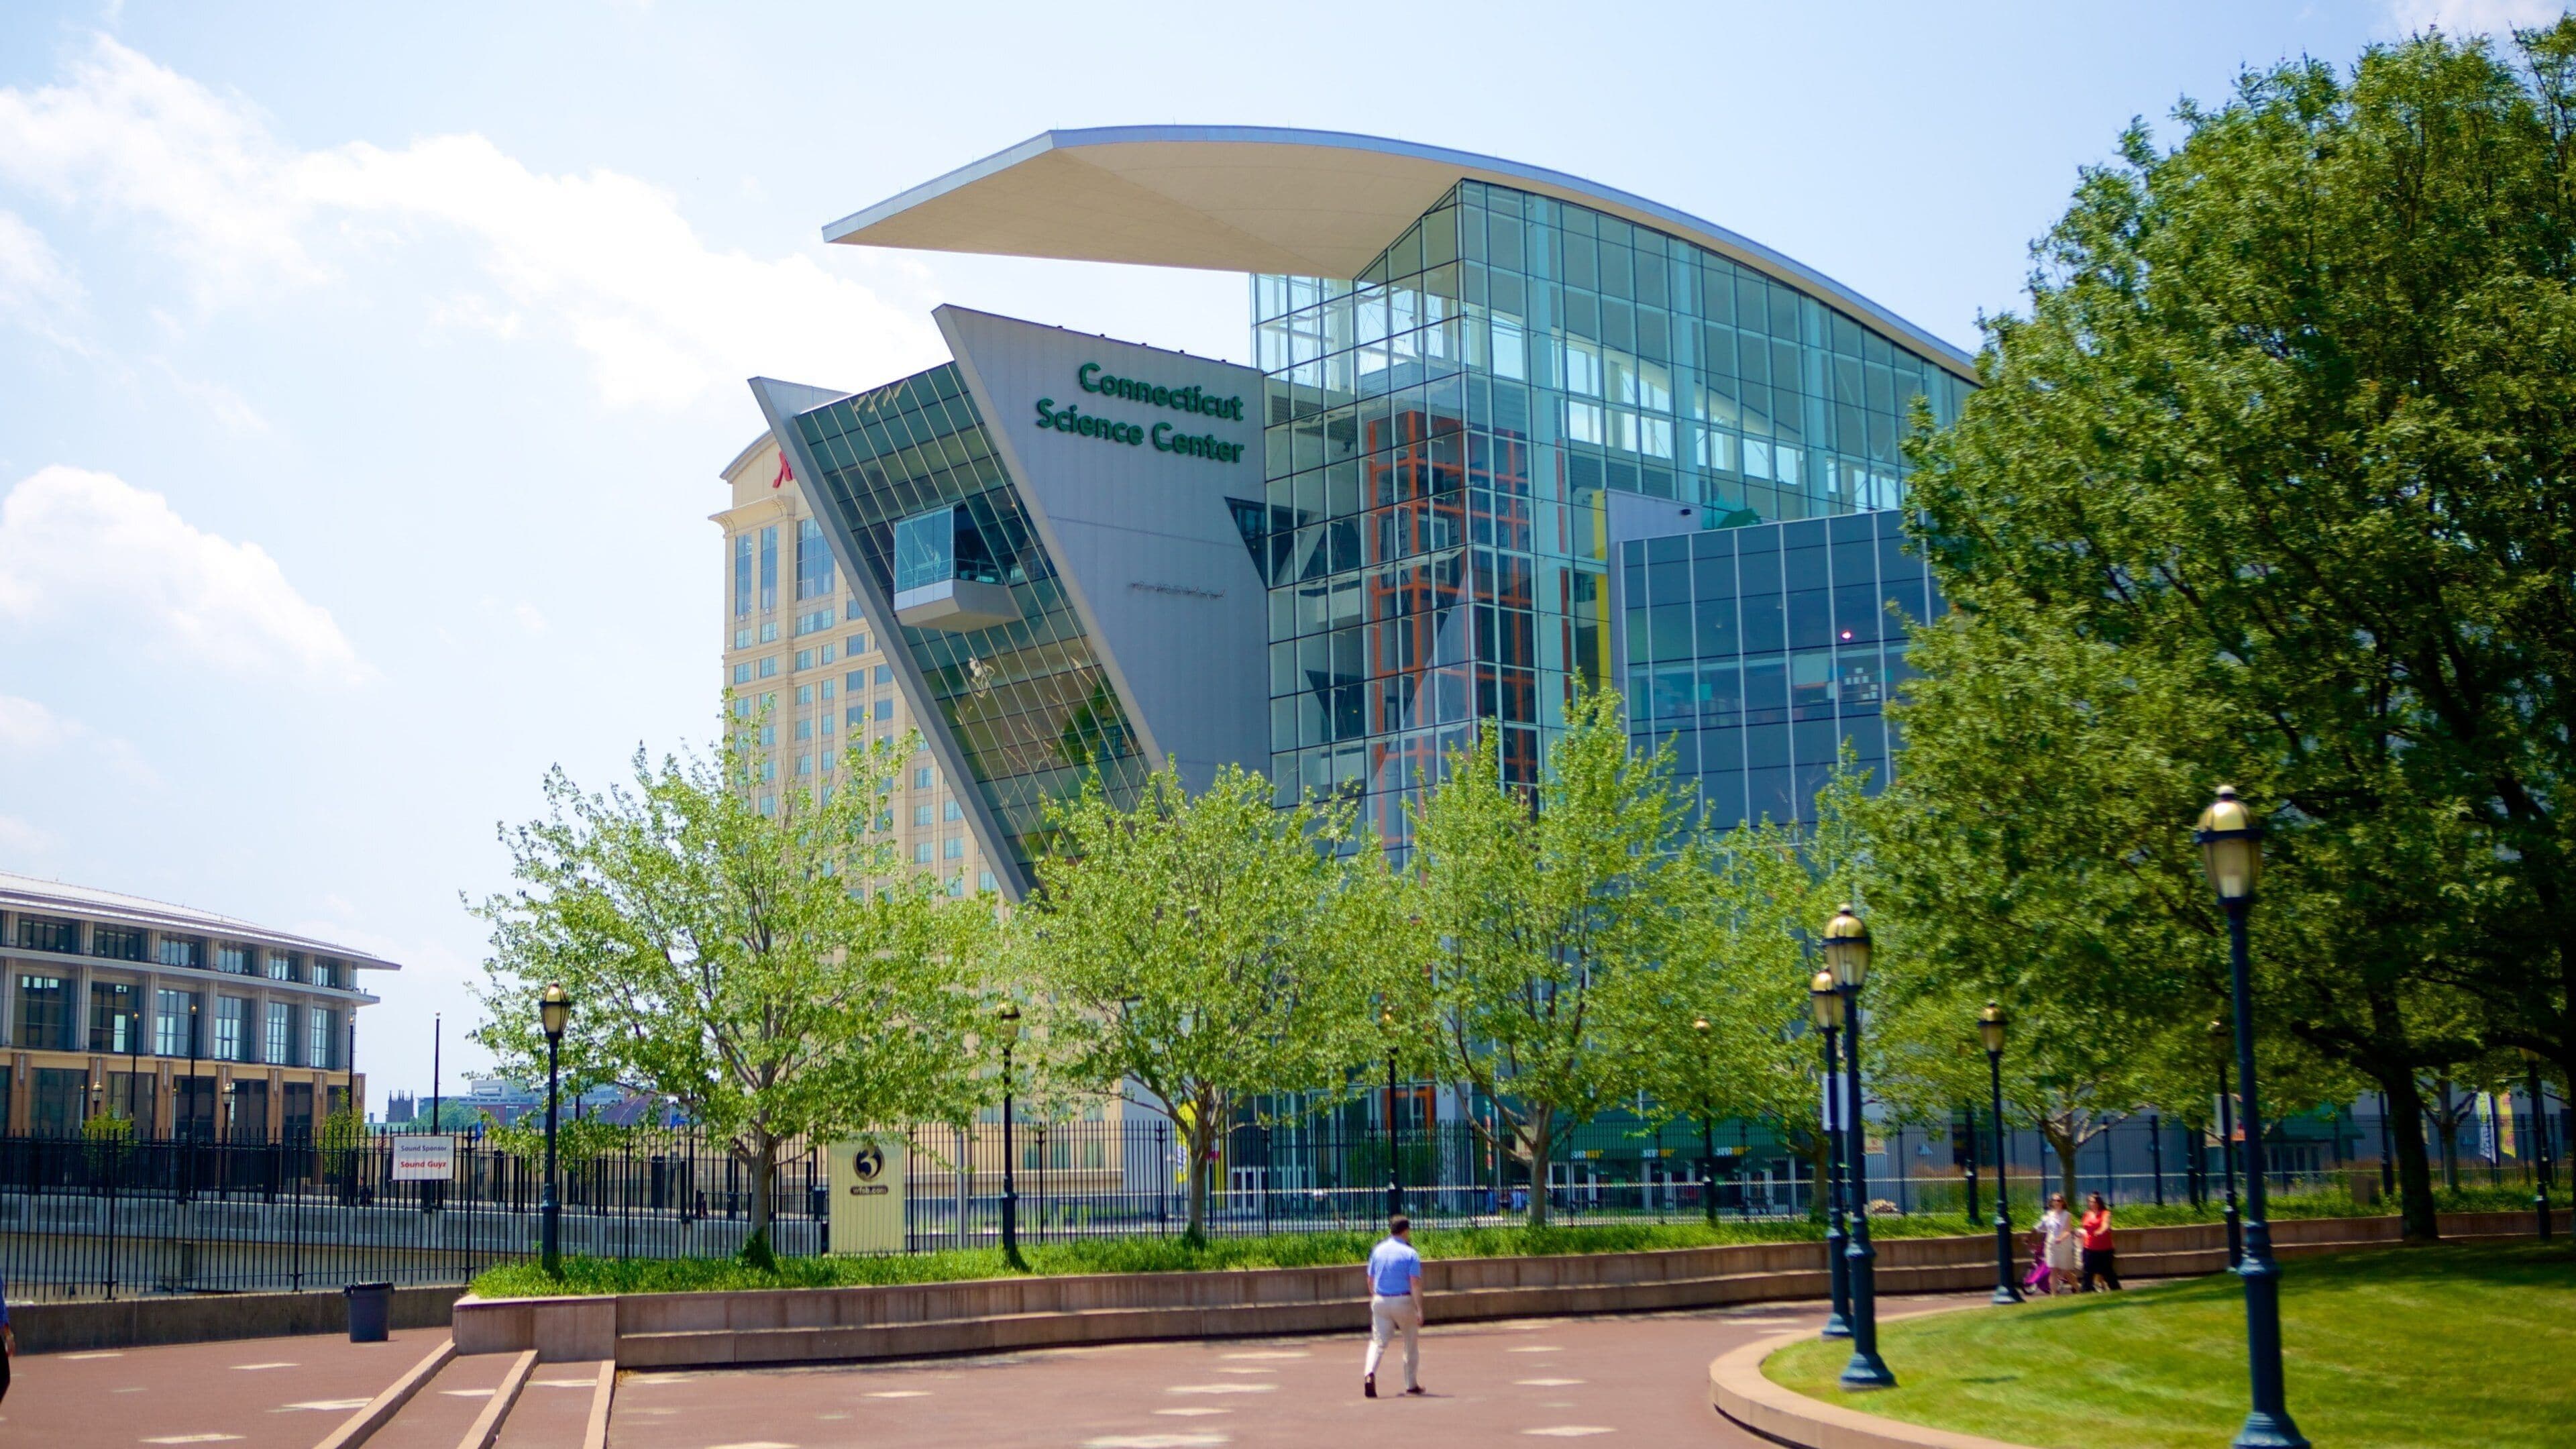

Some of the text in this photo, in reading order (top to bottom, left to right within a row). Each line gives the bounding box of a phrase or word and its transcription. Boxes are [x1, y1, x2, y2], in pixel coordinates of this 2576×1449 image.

[1079, 362, 1244, 421] Connecticut
[1036, 398, 1245, 464] Science Center
[427, 1161, 447, 1169] Guyz
